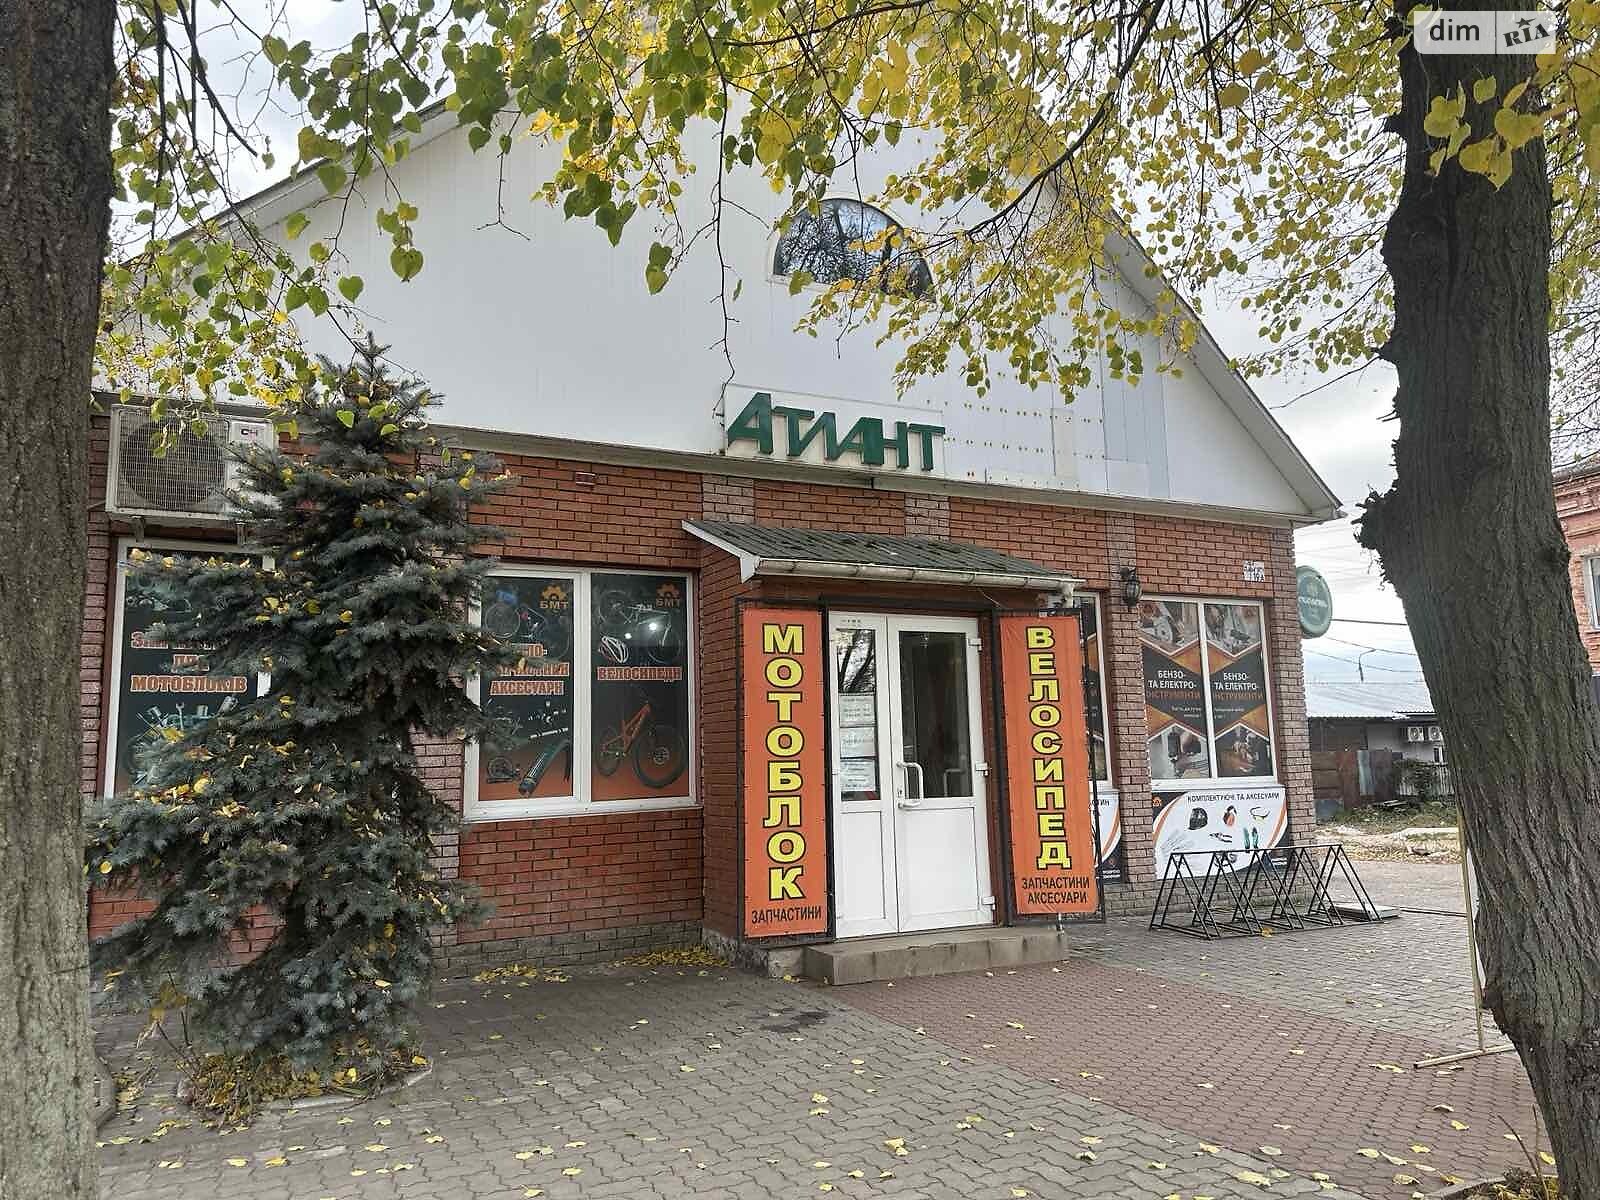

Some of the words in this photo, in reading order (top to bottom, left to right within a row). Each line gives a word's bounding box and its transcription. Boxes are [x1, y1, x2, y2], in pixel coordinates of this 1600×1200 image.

[1158, 670, 1187, 679] БЕНЗО-
[1223, 672, 1249, 681] БЕНЗО-
[490, 680, 564, 696] АКСЕСУАРИ
[1148, 680, 1159, 689] ТА
[1160, 680, 1197, 689] ЕЛЕКТРО-
[1214, 682, 1224, 691] ТА
[1225, 682, 1259, 691] ЕЛЕКТРО-
[1025, 626, 1072, 870] ВЕЛОСИПЕД
[762, 623, 806, 901] МОТОБЛОК
[1246, 792, 1280, 800] АКСЕСУАРИ
[1021, 874, 1090, 891] ЗАПЧАСТИНИ
[1027, 890, 1088, 905] АКСЕСУАРИ
[751, 905, 822, 925] ЗАПЧАСТИНИ
